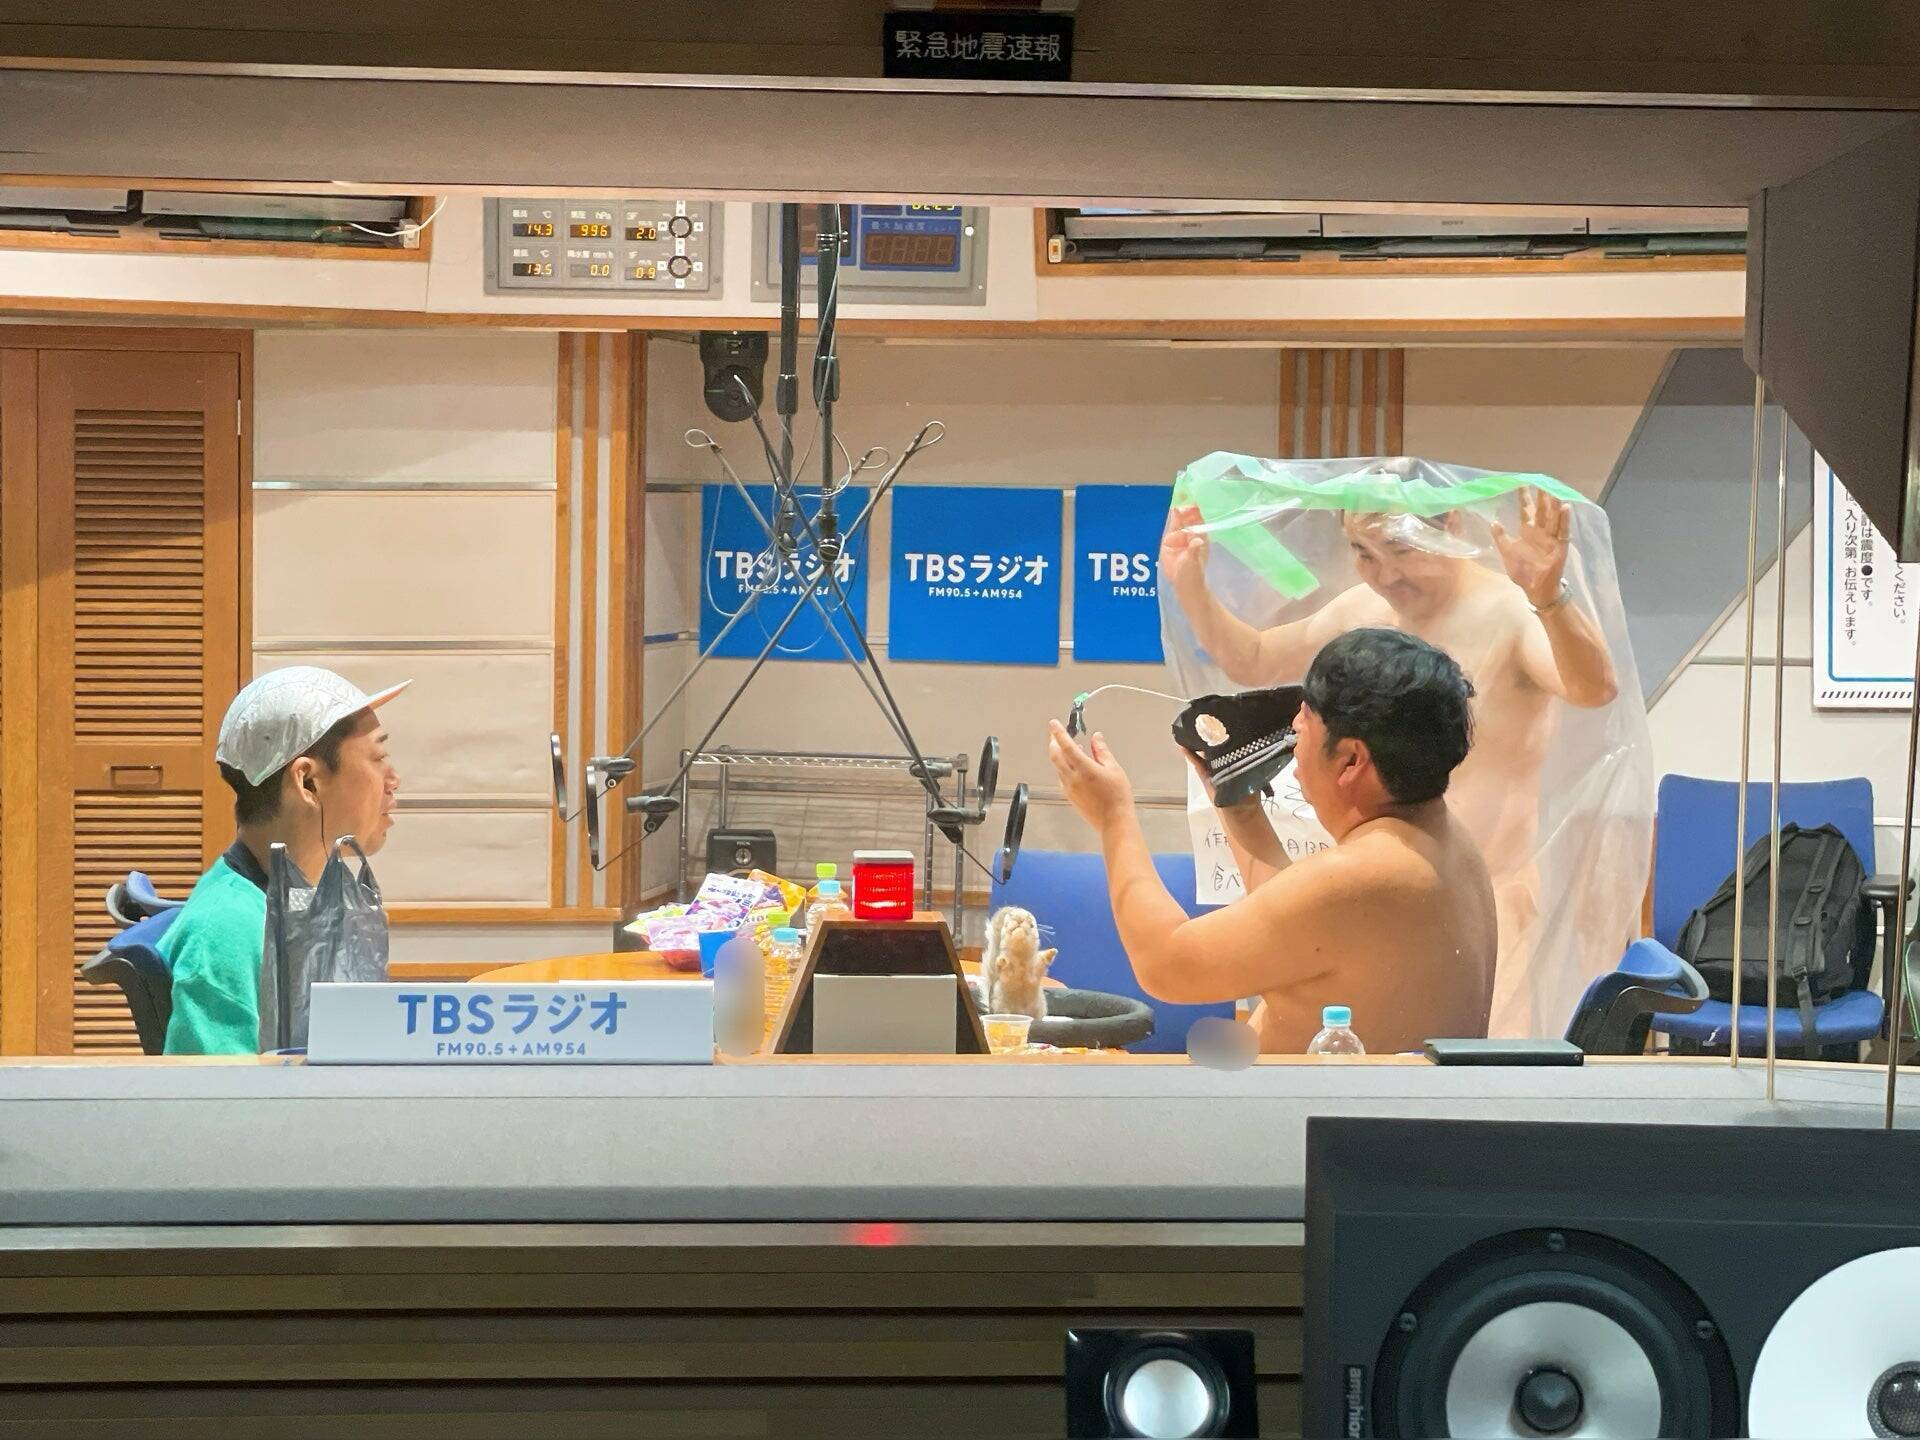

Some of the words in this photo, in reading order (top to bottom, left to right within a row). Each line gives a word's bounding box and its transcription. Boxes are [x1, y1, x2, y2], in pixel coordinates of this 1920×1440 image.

[895, 30, 1062, 62] 緊急地震速報
[527, 223, 553, 236] 14.3
[581, 224, 608, 237] 996
[636, 227, 656, 240] 2.0
[527, 263, 552, 276] 13.5
[590, 264, 610, 277] 0.0
[904, 553, 1049, 586] TBSラジオ
[1088, 552, 1159, 582] TBS
[928, 586, 1023, 599] FM90.5+AM954
[398, 991, 628, 1036] TBSラジオ
[437, 1042, 586, 1057] FM90.5+AM954
